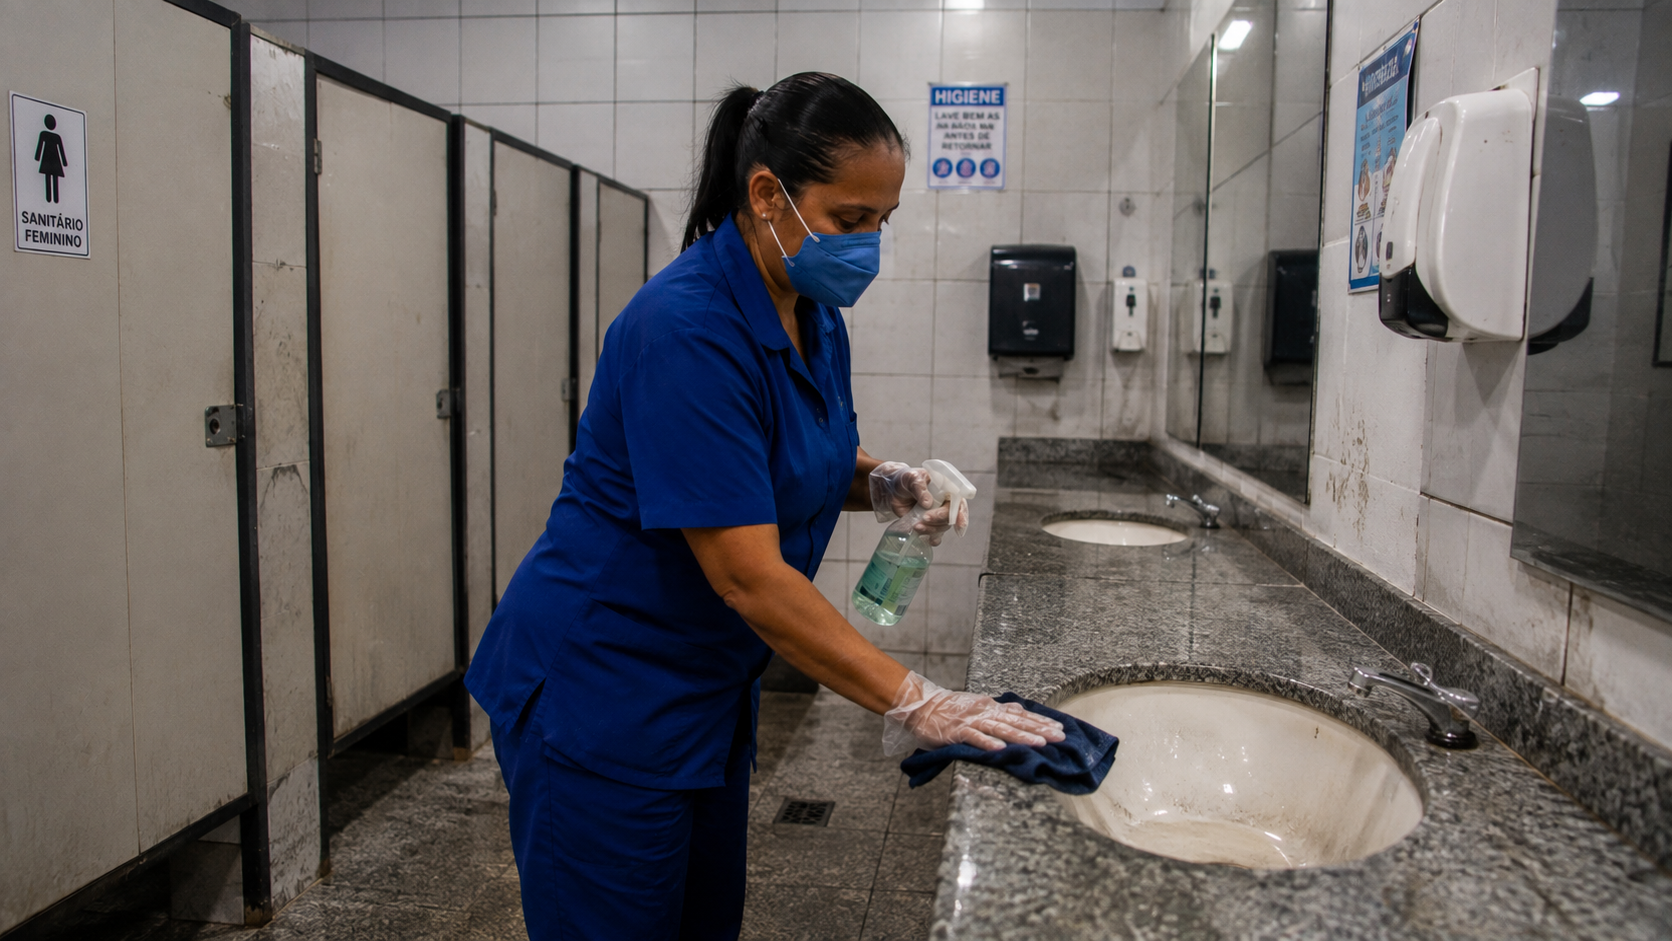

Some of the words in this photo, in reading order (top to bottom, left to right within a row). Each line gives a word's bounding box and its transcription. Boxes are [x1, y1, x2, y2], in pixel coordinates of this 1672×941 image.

[935, 90, 1001, 104] HIGIENE
[935, 112, 959, 120] LAVE
[987, 112, 1000, 120] AS
[944, 132, 975, 140] ANTES
[21, 211, 83, 231] SANITÁRIO
[25, 229, 82, 248] FEMININO
